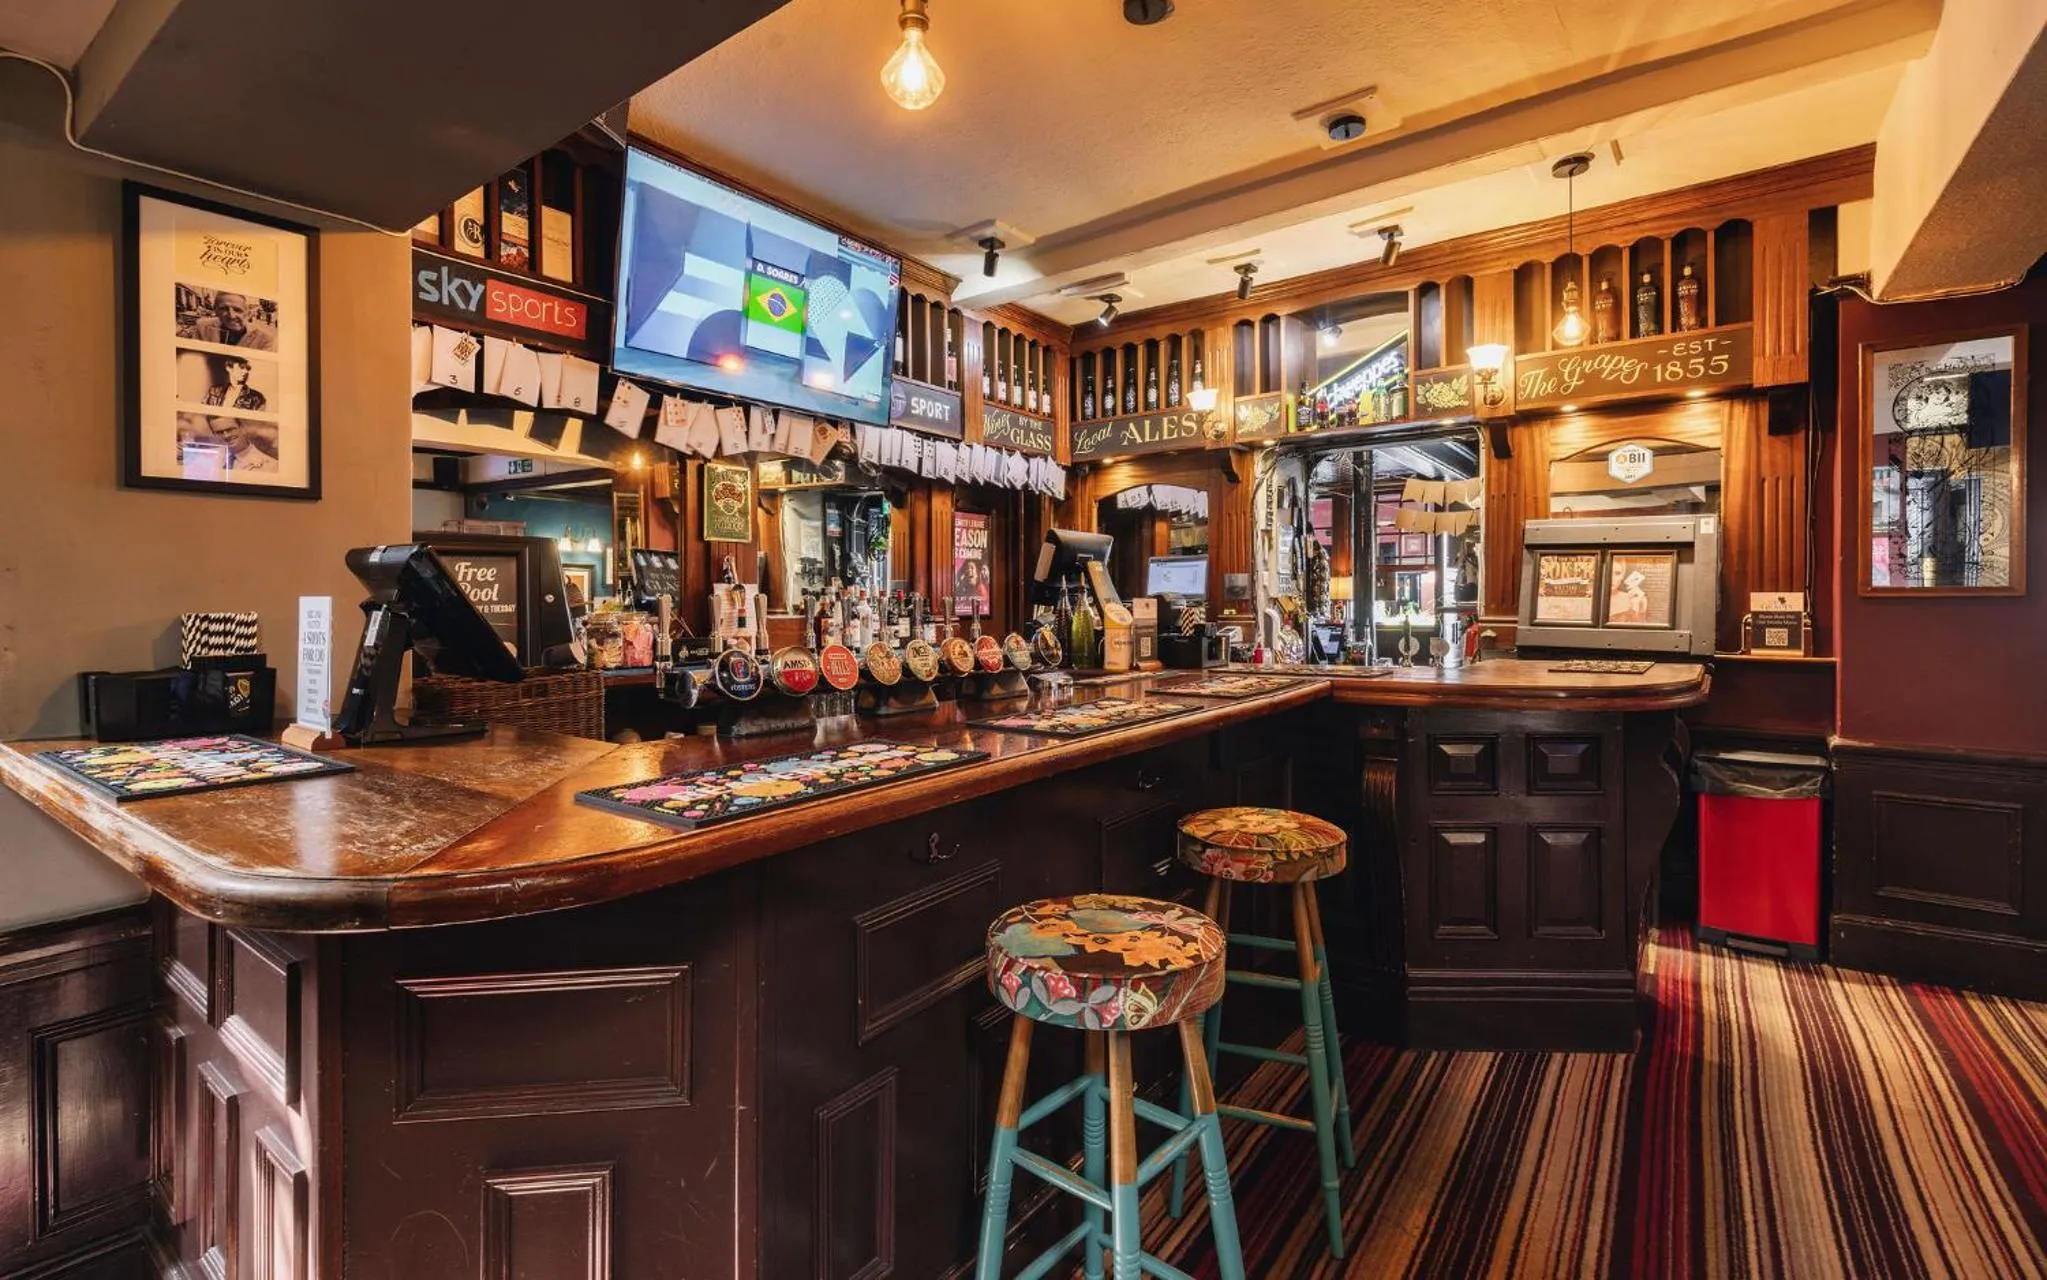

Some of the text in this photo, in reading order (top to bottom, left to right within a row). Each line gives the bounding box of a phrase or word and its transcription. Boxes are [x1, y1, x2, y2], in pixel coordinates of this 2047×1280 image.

[417, 266, 577, 328] sky sports
[449, 374, 458, 385] 3
[1519, 354, 1648, 400] The Grapes
[1653, 354, 1730, 383] 1855
[513, 386, 523, 396] 6
[573, 397, 581, 407] 8
[911, 396, 951, 421] SPORT
[1010, 427, 1052, 452] GLASS
[1074, 413, 1198, 454] Local ALES
[454, 561, 498, 582] Free
